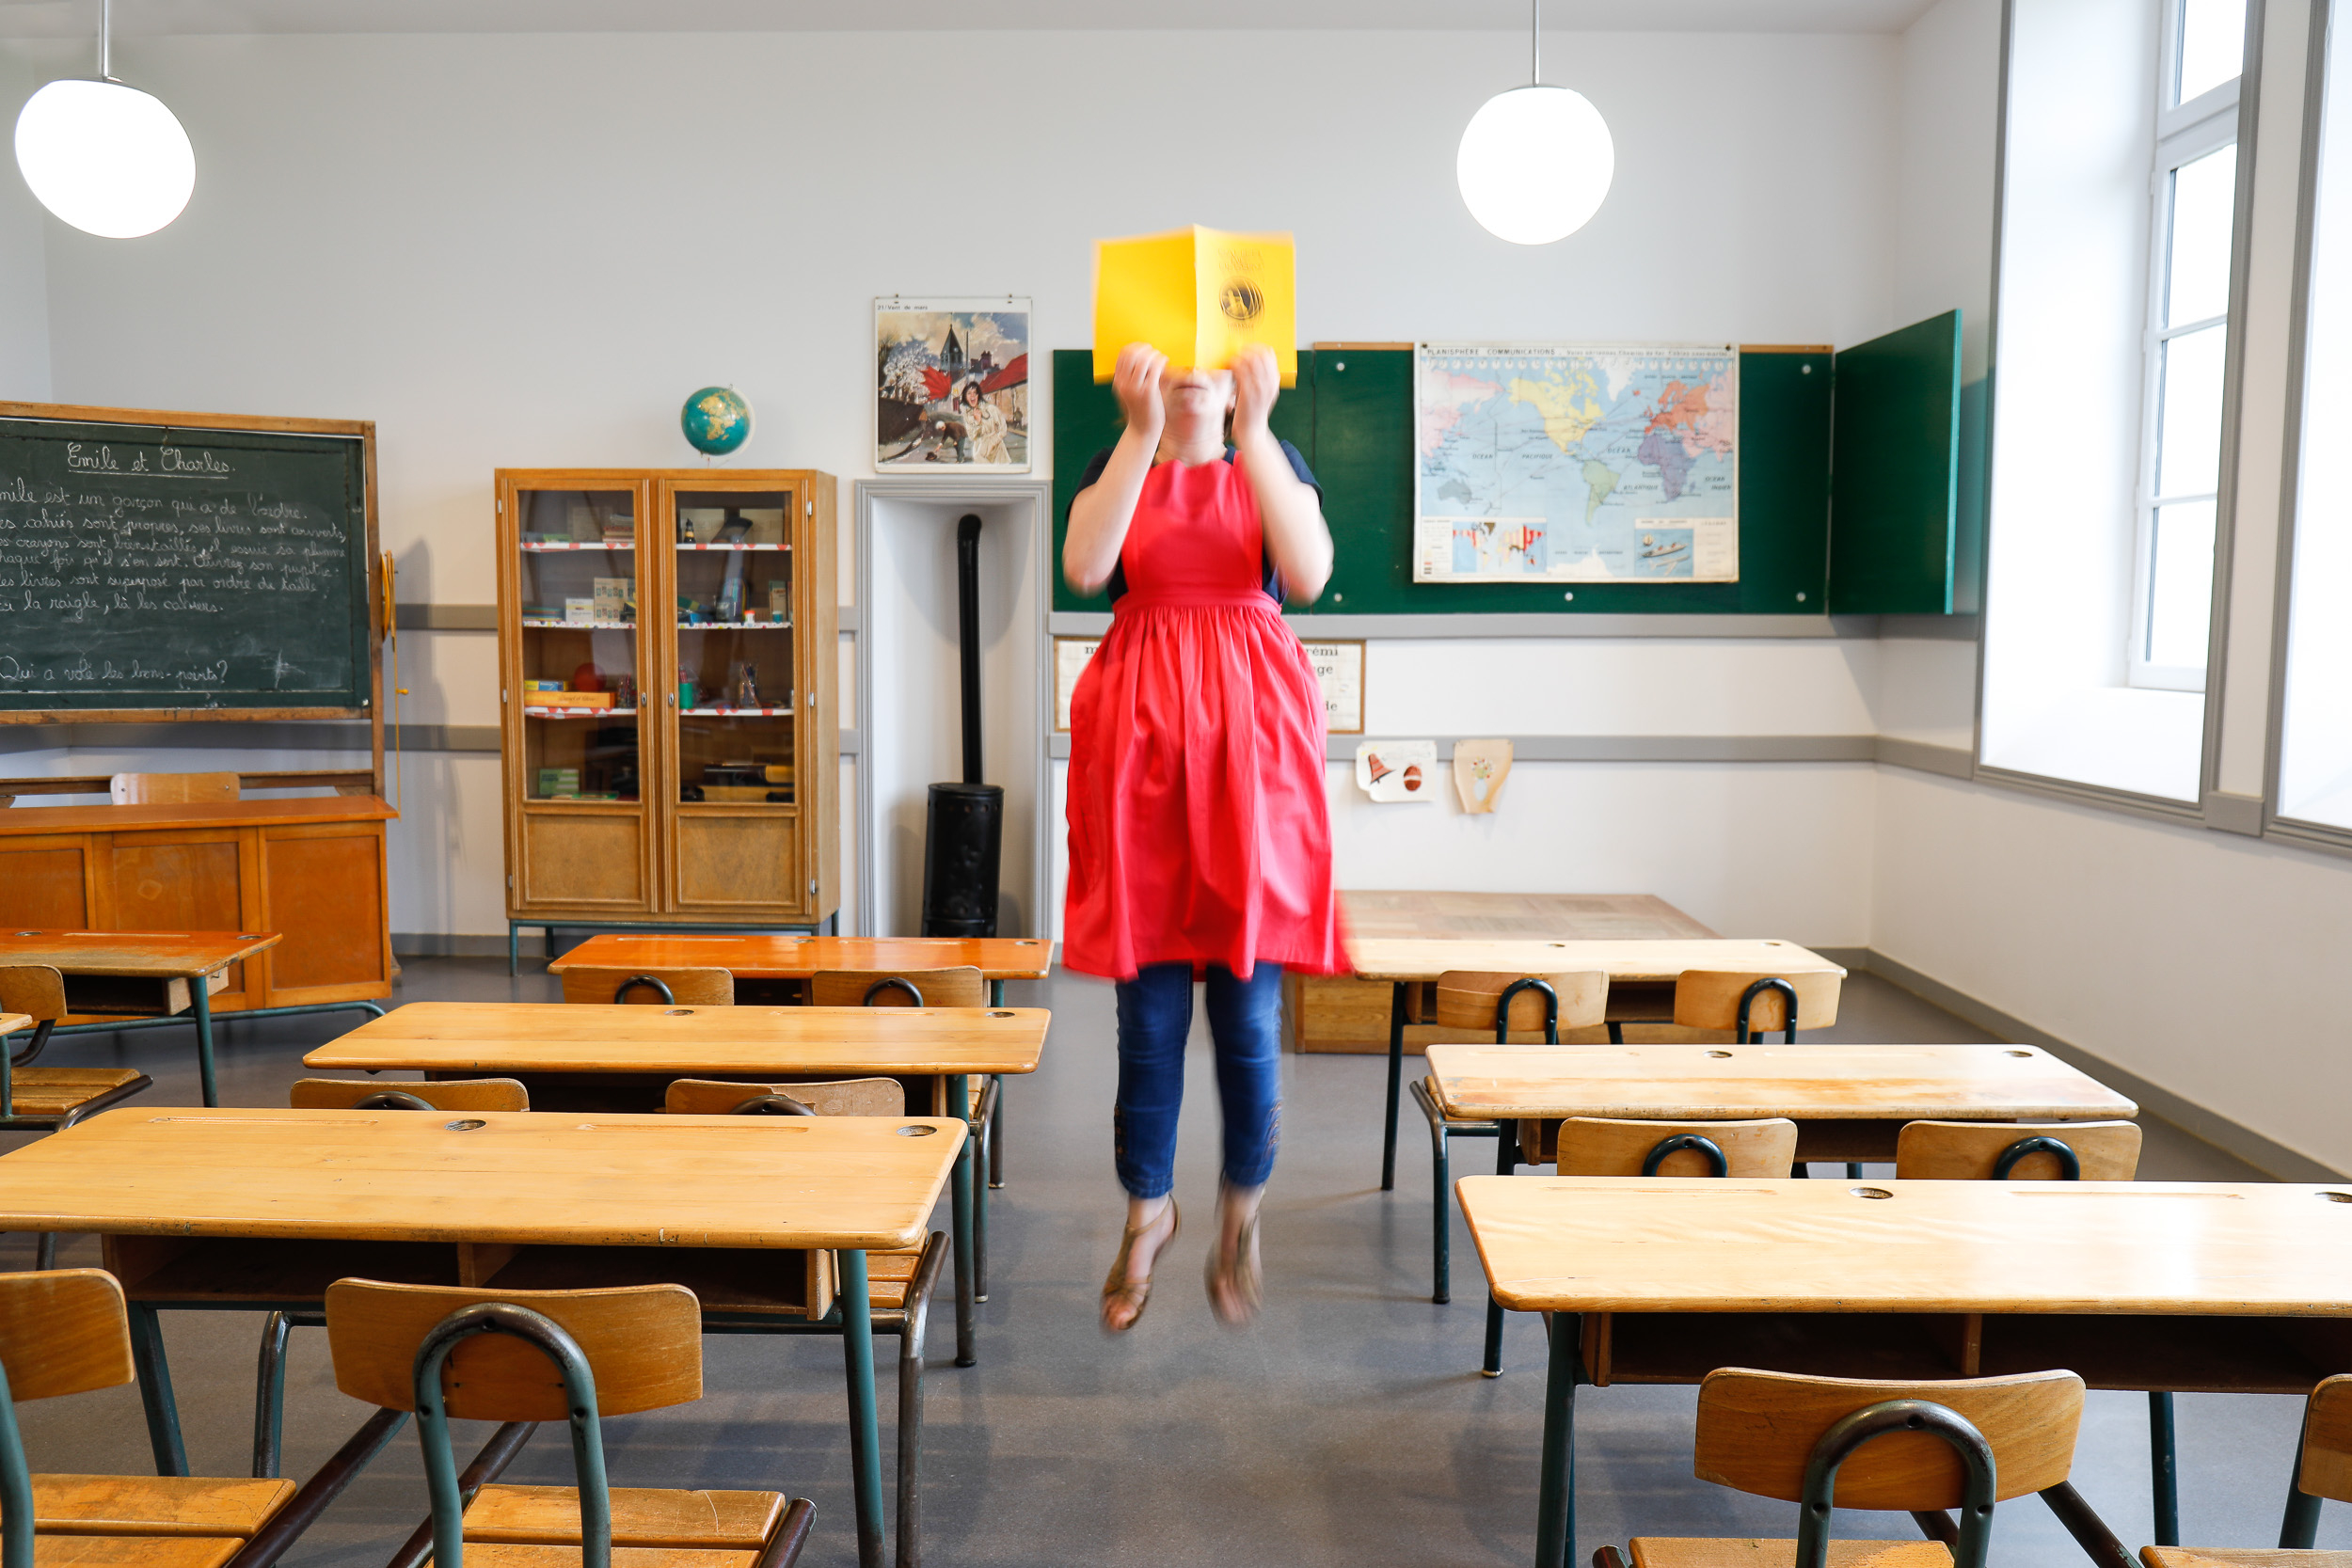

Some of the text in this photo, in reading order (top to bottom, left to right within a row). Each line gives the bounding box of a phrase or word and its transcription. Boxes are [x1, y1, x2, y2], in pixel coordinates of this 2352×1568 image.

[132, 451, 150, 472] et
[44, 486, 71, 506] est
[78, 494, 105, 507] un
[113, 497, 163, 517] garçon
[172, 497, 198, 517] qui
[199, 503, 213, 514] a
[219, 498, 236, 515] de
[83, 515, 119, 531] sont
[189, 525, 211, 533] ses
[215, 515, 251, 534] livres
[260, 522, 286, 535] sont
[16, 539, 70, 557] crayons
[77, 534, 108, 549] sont
[210, 537, 222, 553] il
[276, 545, 295, 556] sa
[50, 549, 75, 572] fois
[248, 562, 275, 571] son
[0, 573, 16, 587] es
[21, 569, 62, 588] livres
[70, 572, 100, 586] sont
[179, 577, 207, 594] par
[213, 575, 252, 590] ordre
[257, 576, 276, 590] de
[24, 589, 42, 611] la
[114, 592, 132, 610] là
[136, 591, 158, 610] les
[43, 669, 56, 680] a
[102, 660, 123, 680] les
